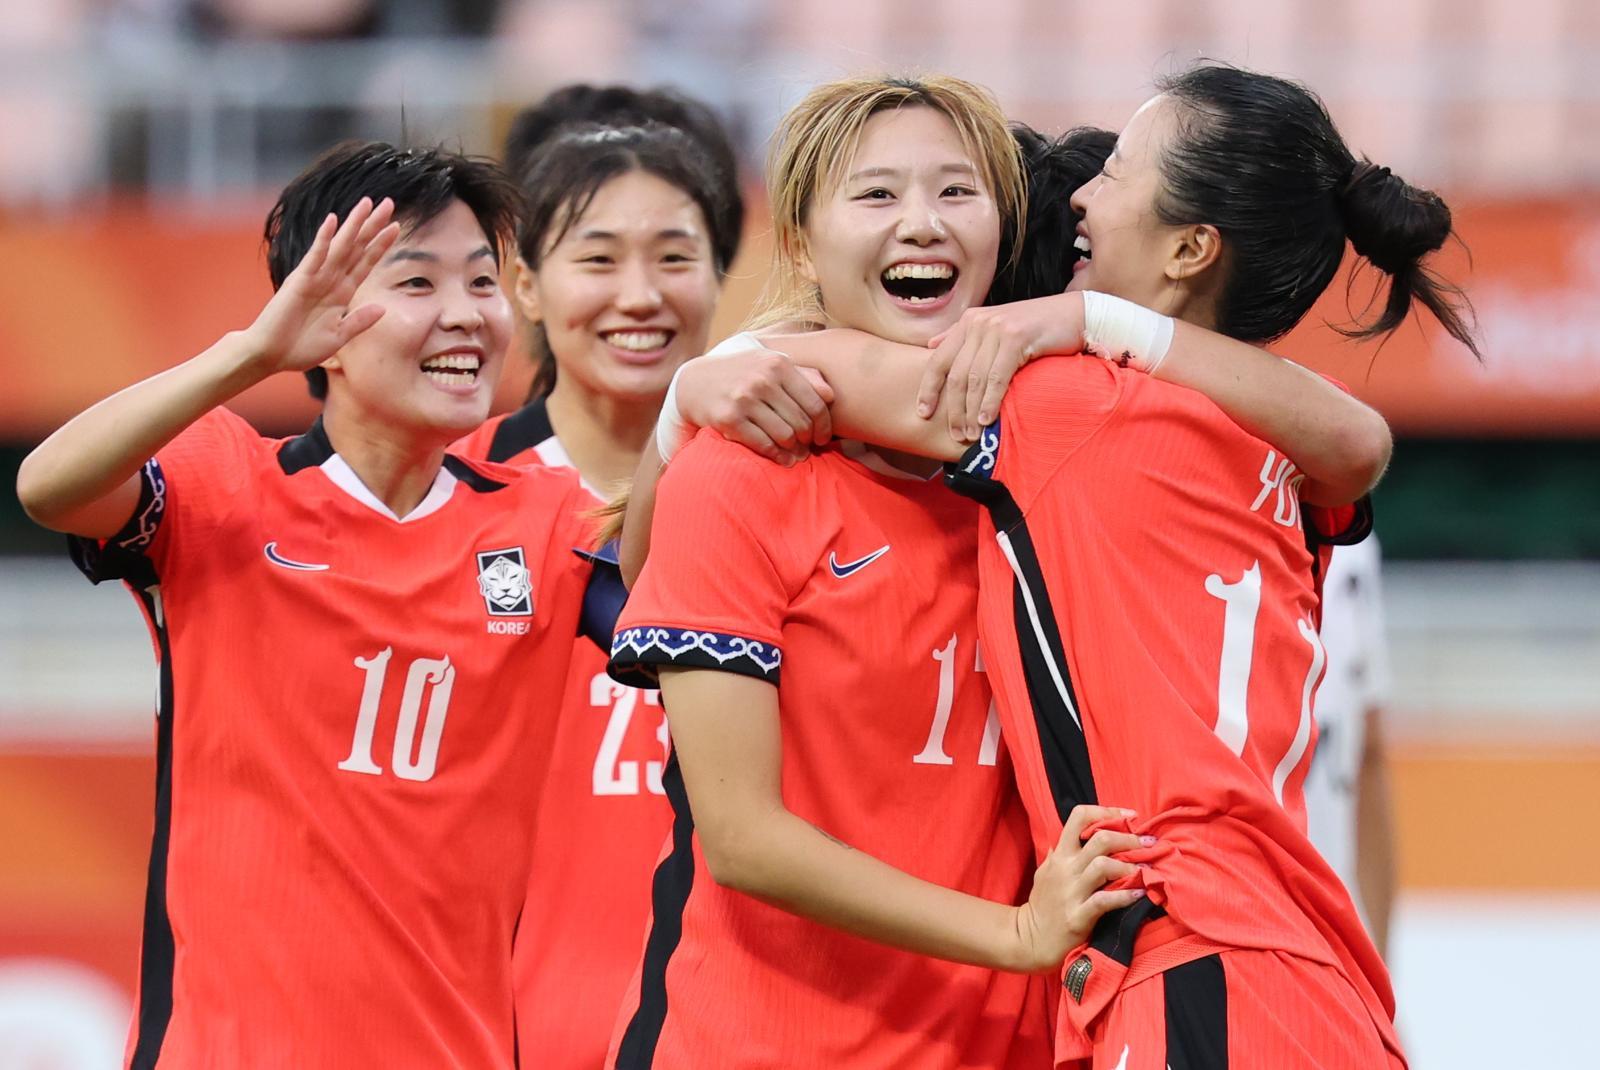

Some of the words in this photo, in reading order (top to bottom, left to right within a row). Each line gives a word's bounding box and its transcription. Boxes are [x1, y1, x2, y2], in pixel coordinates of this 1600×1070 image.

[486, 620, 531, 636] KOREA
[1204, 559, 1326, 808] 11
[337, 645, 457, 782] 10
